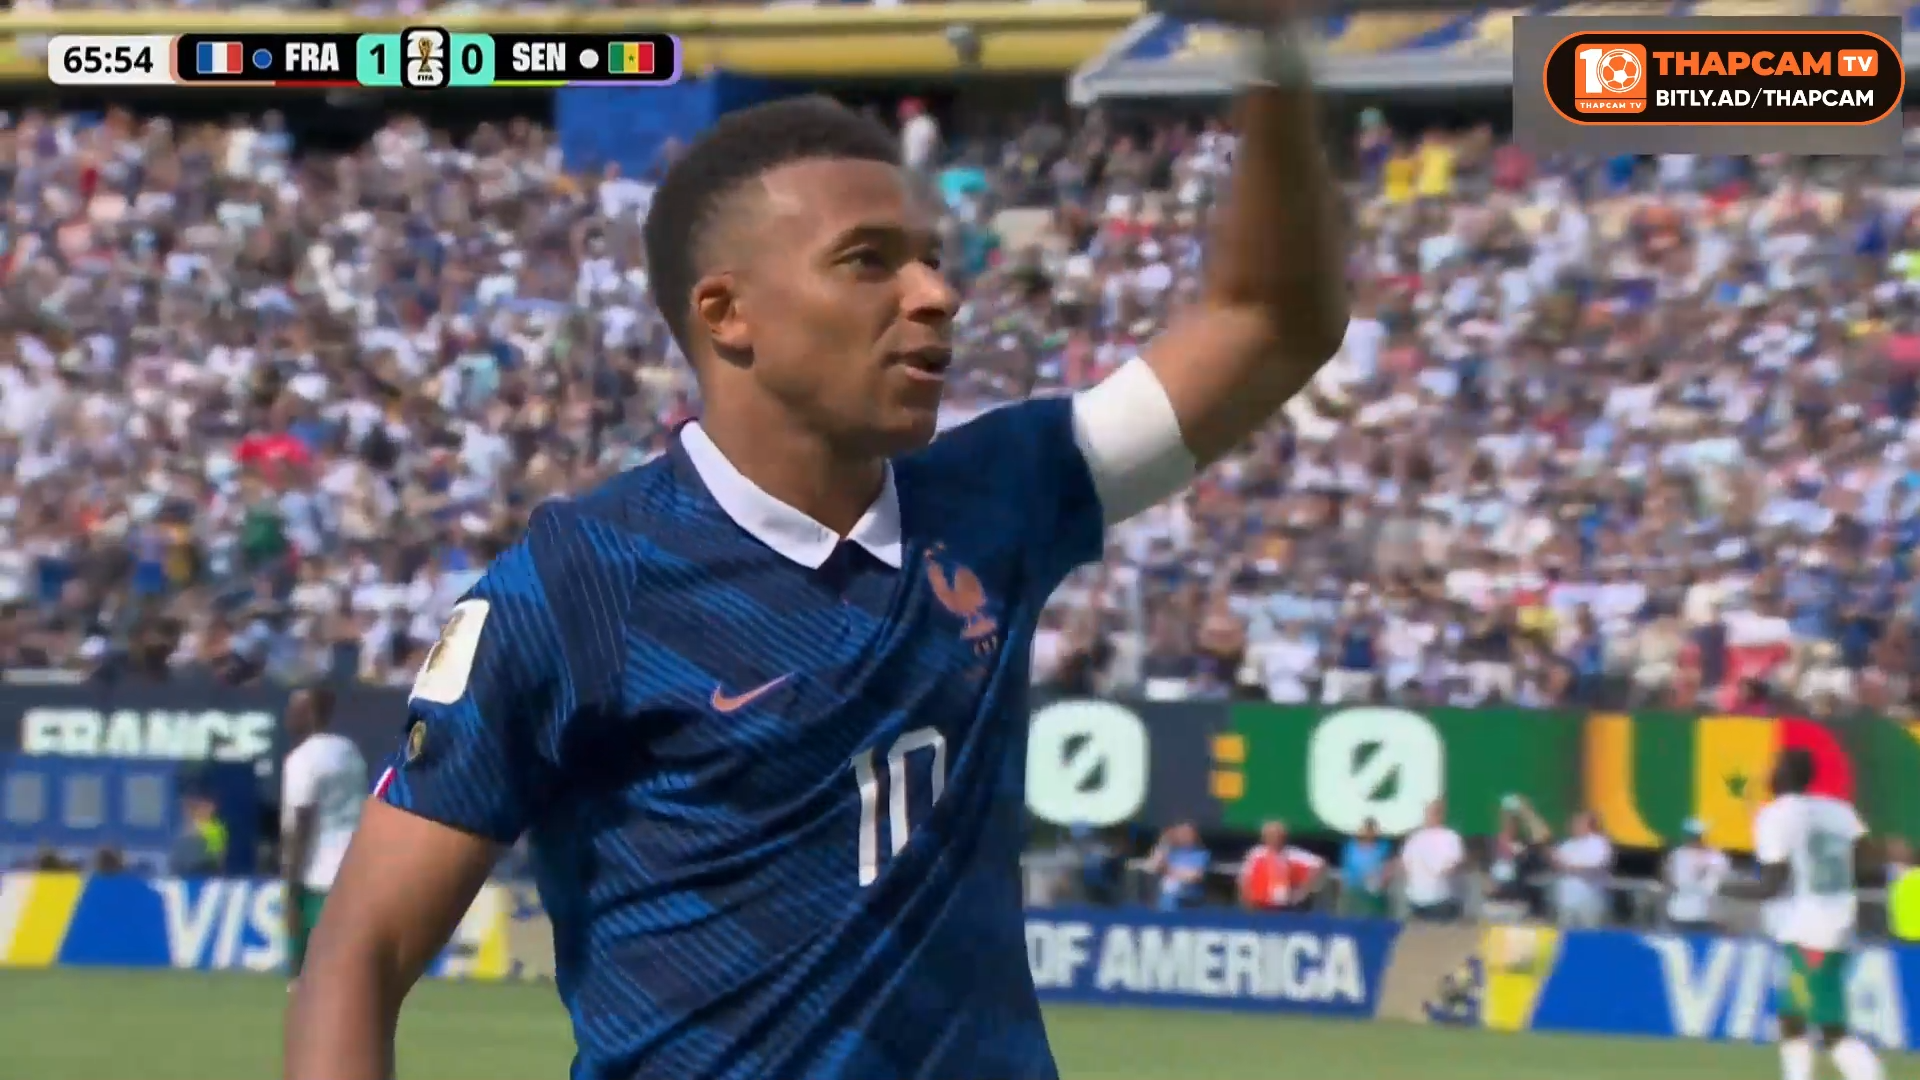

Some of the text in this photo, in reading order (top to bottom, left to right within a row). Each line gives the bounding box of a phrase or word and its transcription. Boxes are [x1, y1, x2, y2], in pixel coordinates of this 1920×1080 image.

[22, 706, 275, 766] FRANCE
[851, 725, 947, 887] 10
[148, 879, 289, 970] VIS
[1025, 919, 1365, 1003] OF AMERICA
[1642, 933, 1908, 1049] VIA
